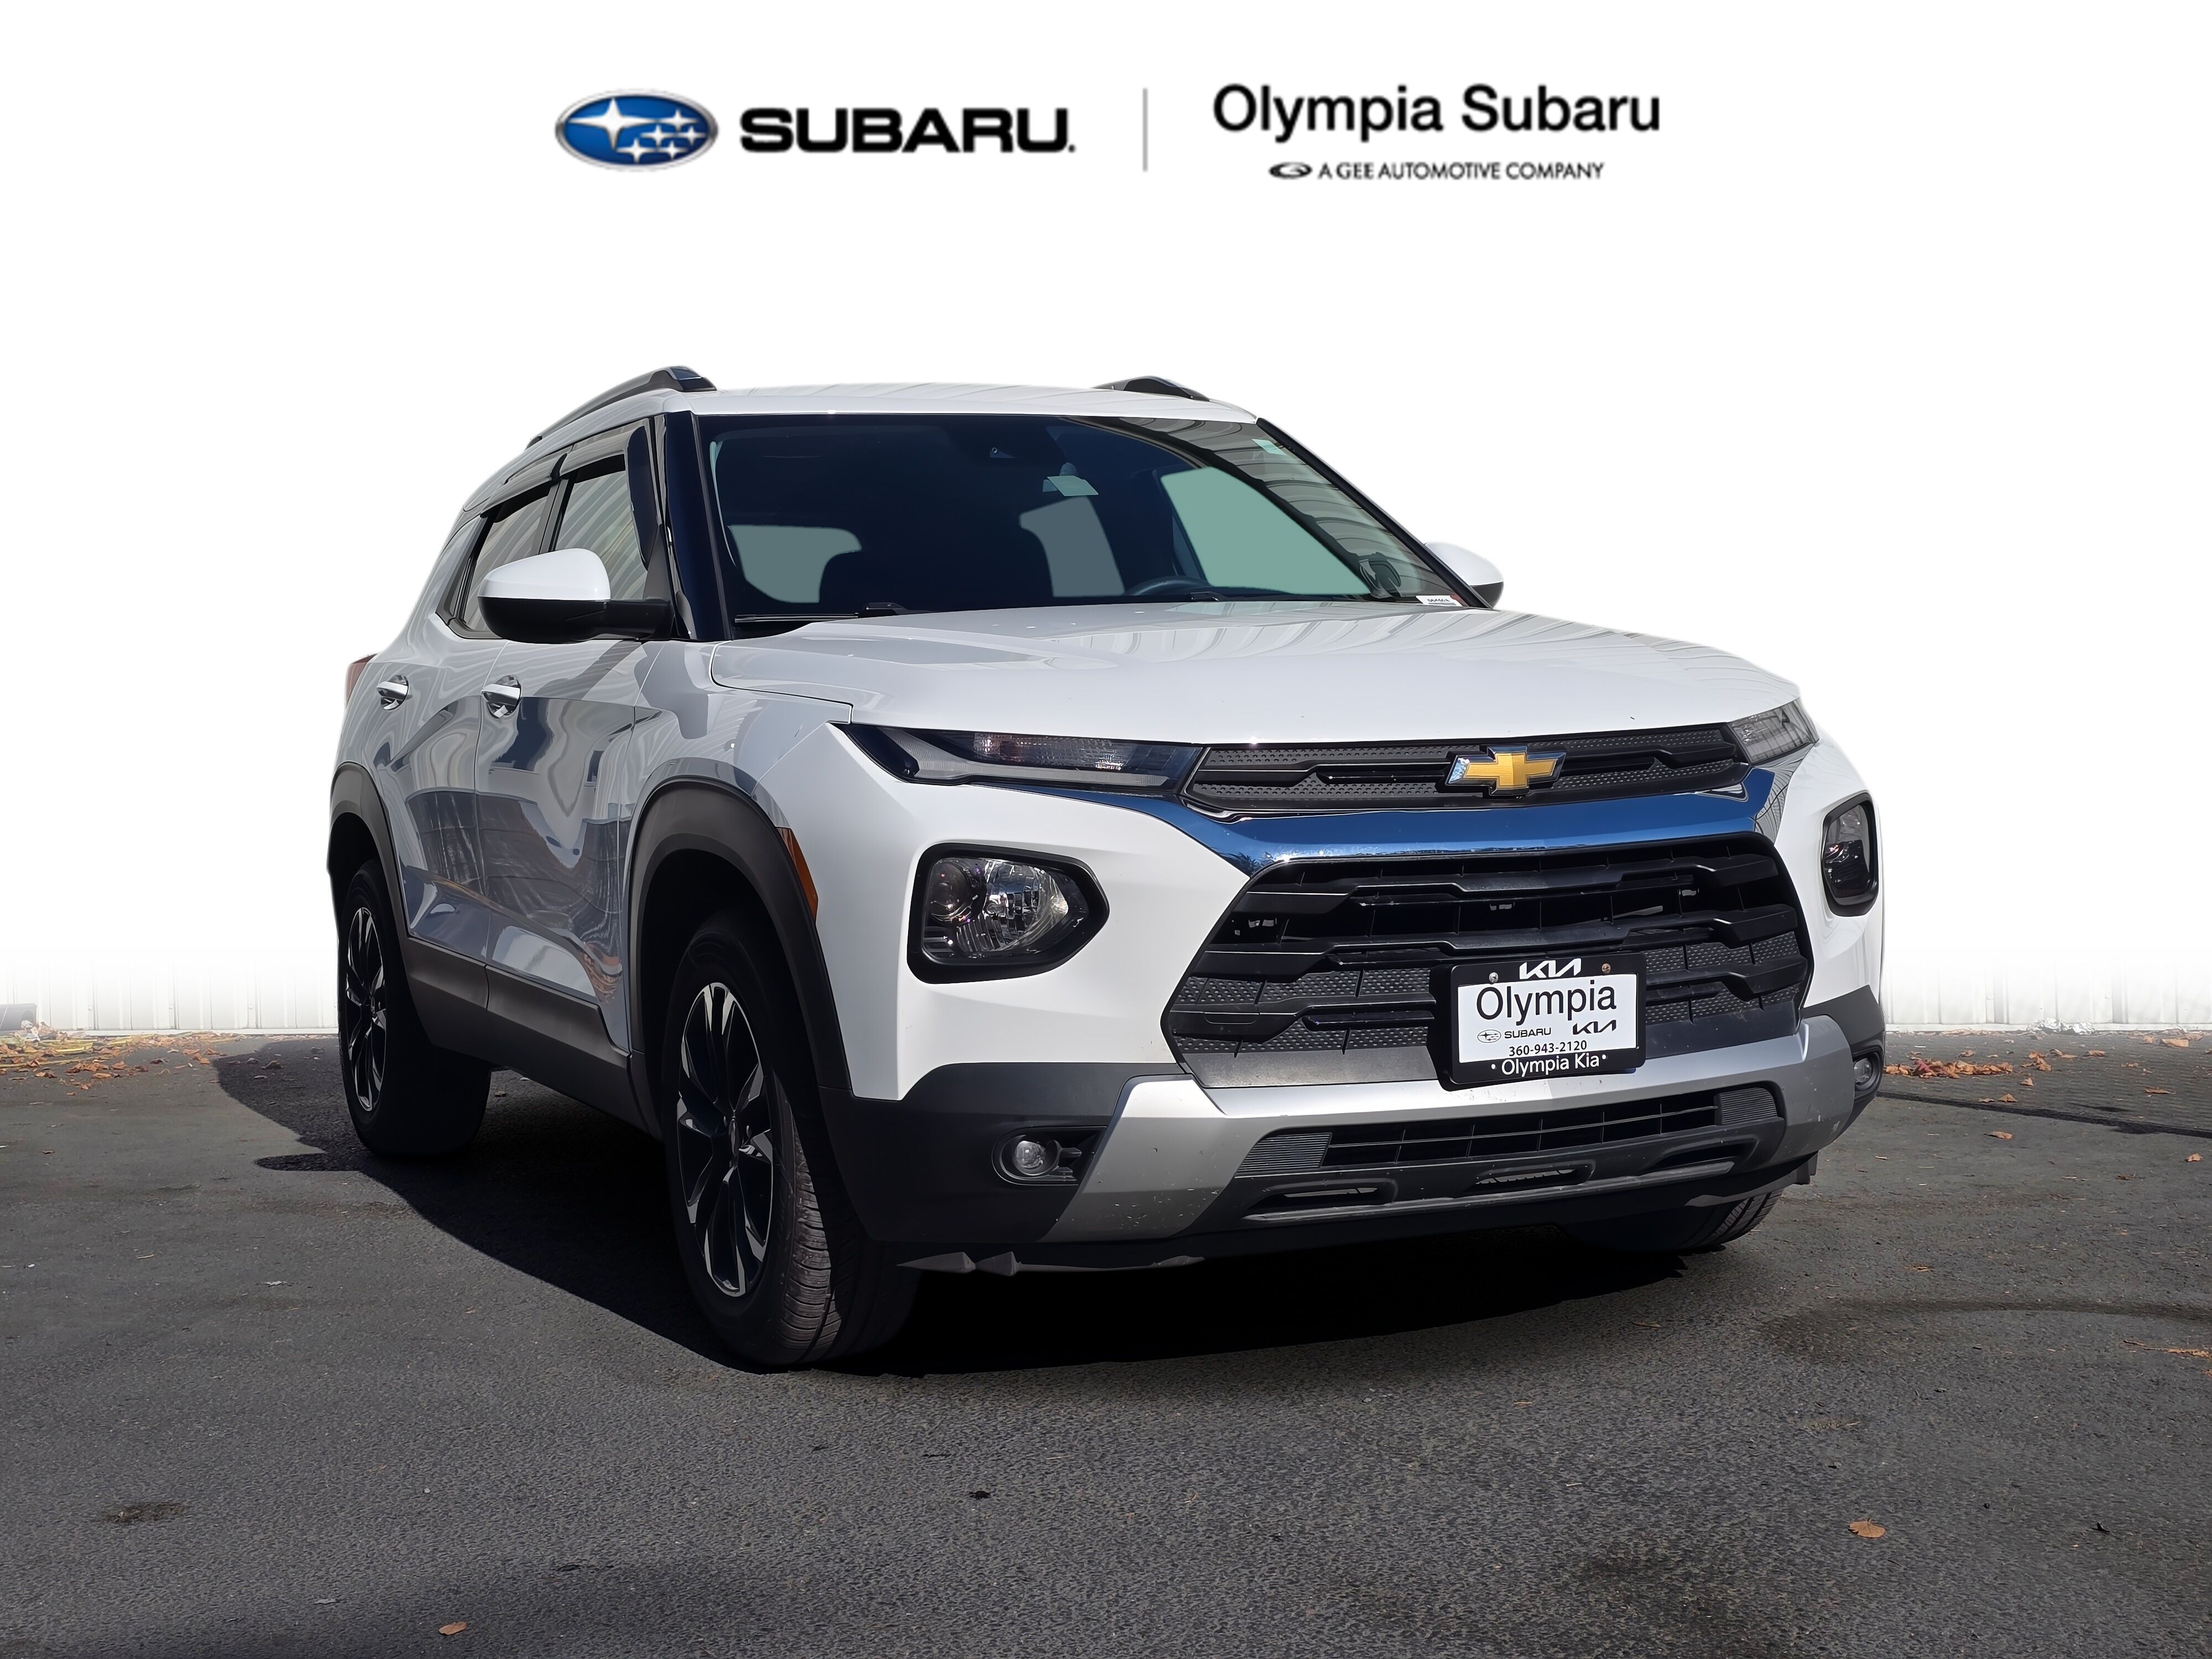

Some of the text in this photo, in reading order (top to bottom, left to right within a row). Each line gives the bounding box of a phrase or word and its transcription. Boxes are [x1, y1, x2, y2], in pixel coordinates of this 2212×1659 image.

[1476, 979, 1617, 1026] Olympia
[1504, 1027, 1552, 1039] SUBARU
[1509, 1040, 1588, 1057] 360-943-2120
[1501, 1052, 1600, 1077] Olympia Kia
